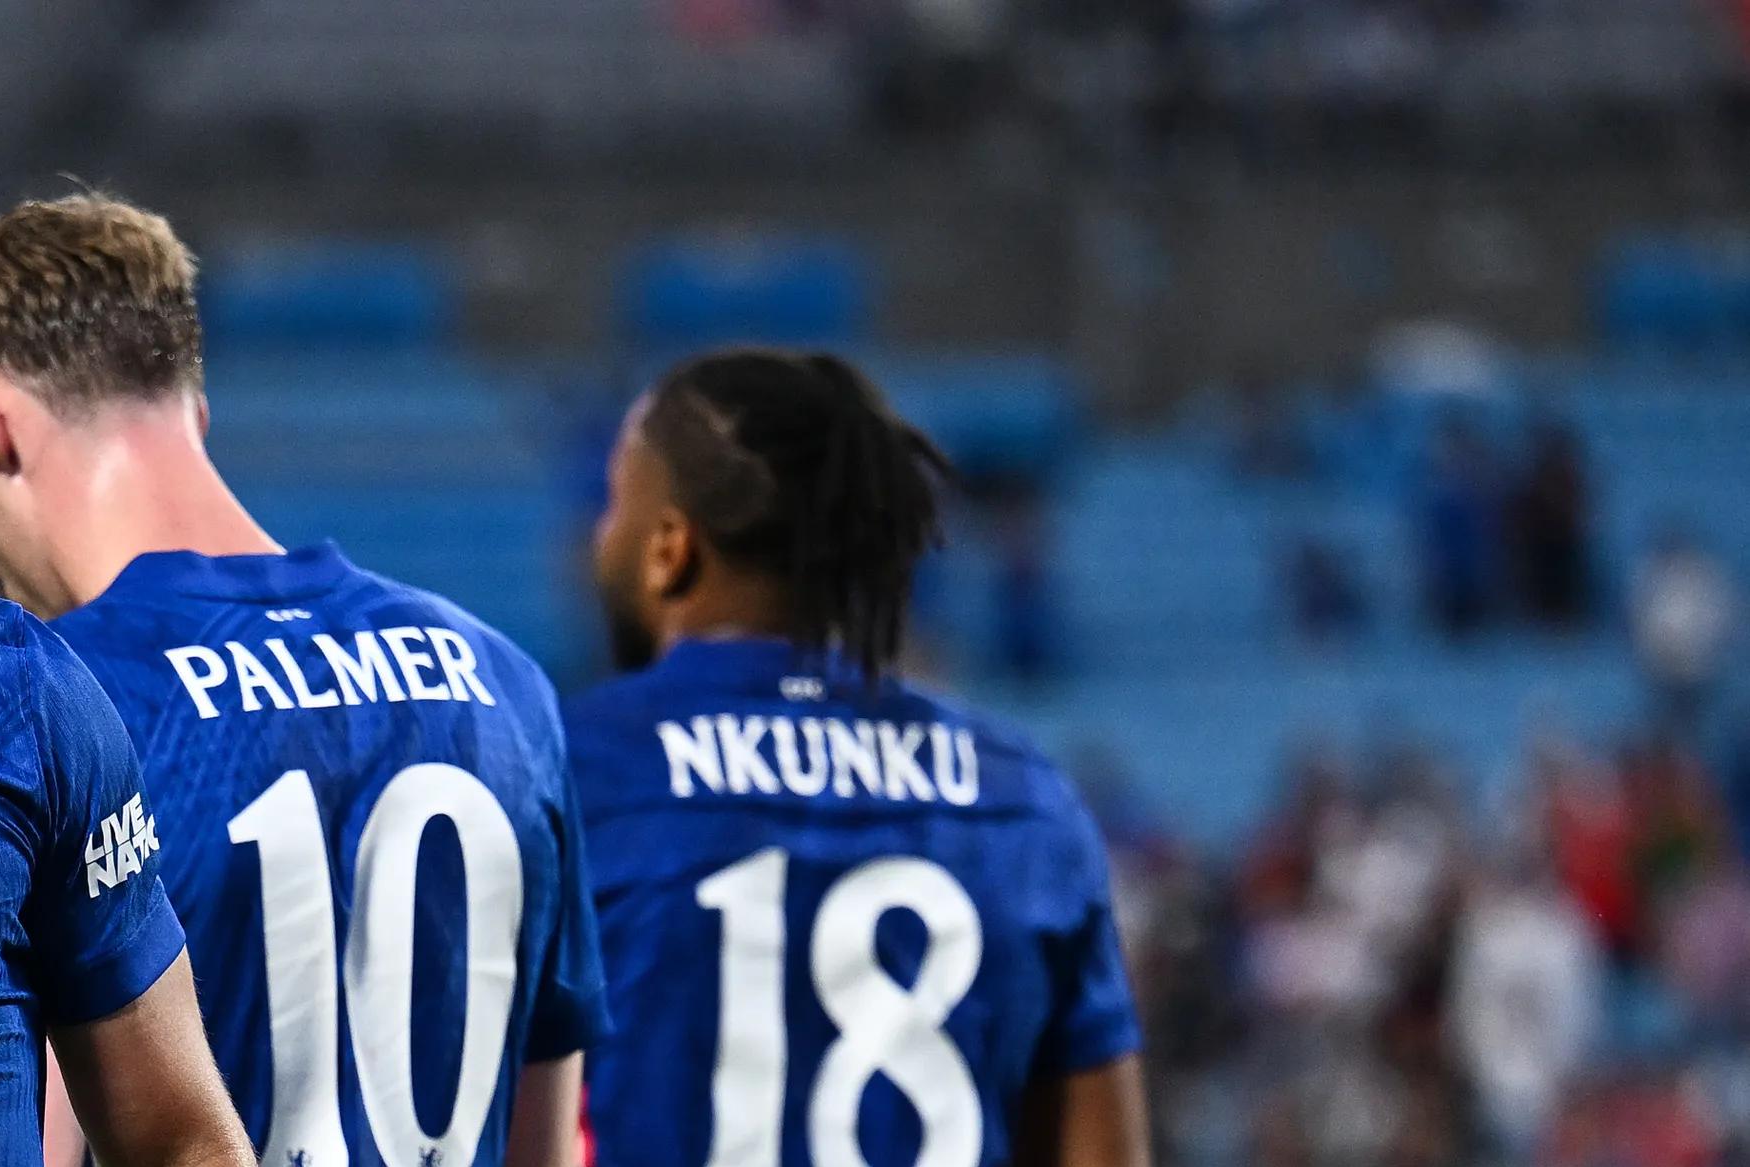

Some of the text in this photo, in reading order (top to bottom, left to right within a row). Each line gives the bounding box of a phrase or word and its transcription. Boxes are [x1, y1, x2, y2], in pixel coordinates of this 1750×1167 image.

[163, 626, 497, 719] PALMER
[655, 712, 980, 806] NKUNKU
[85, 791, 147, 866] LIVE
